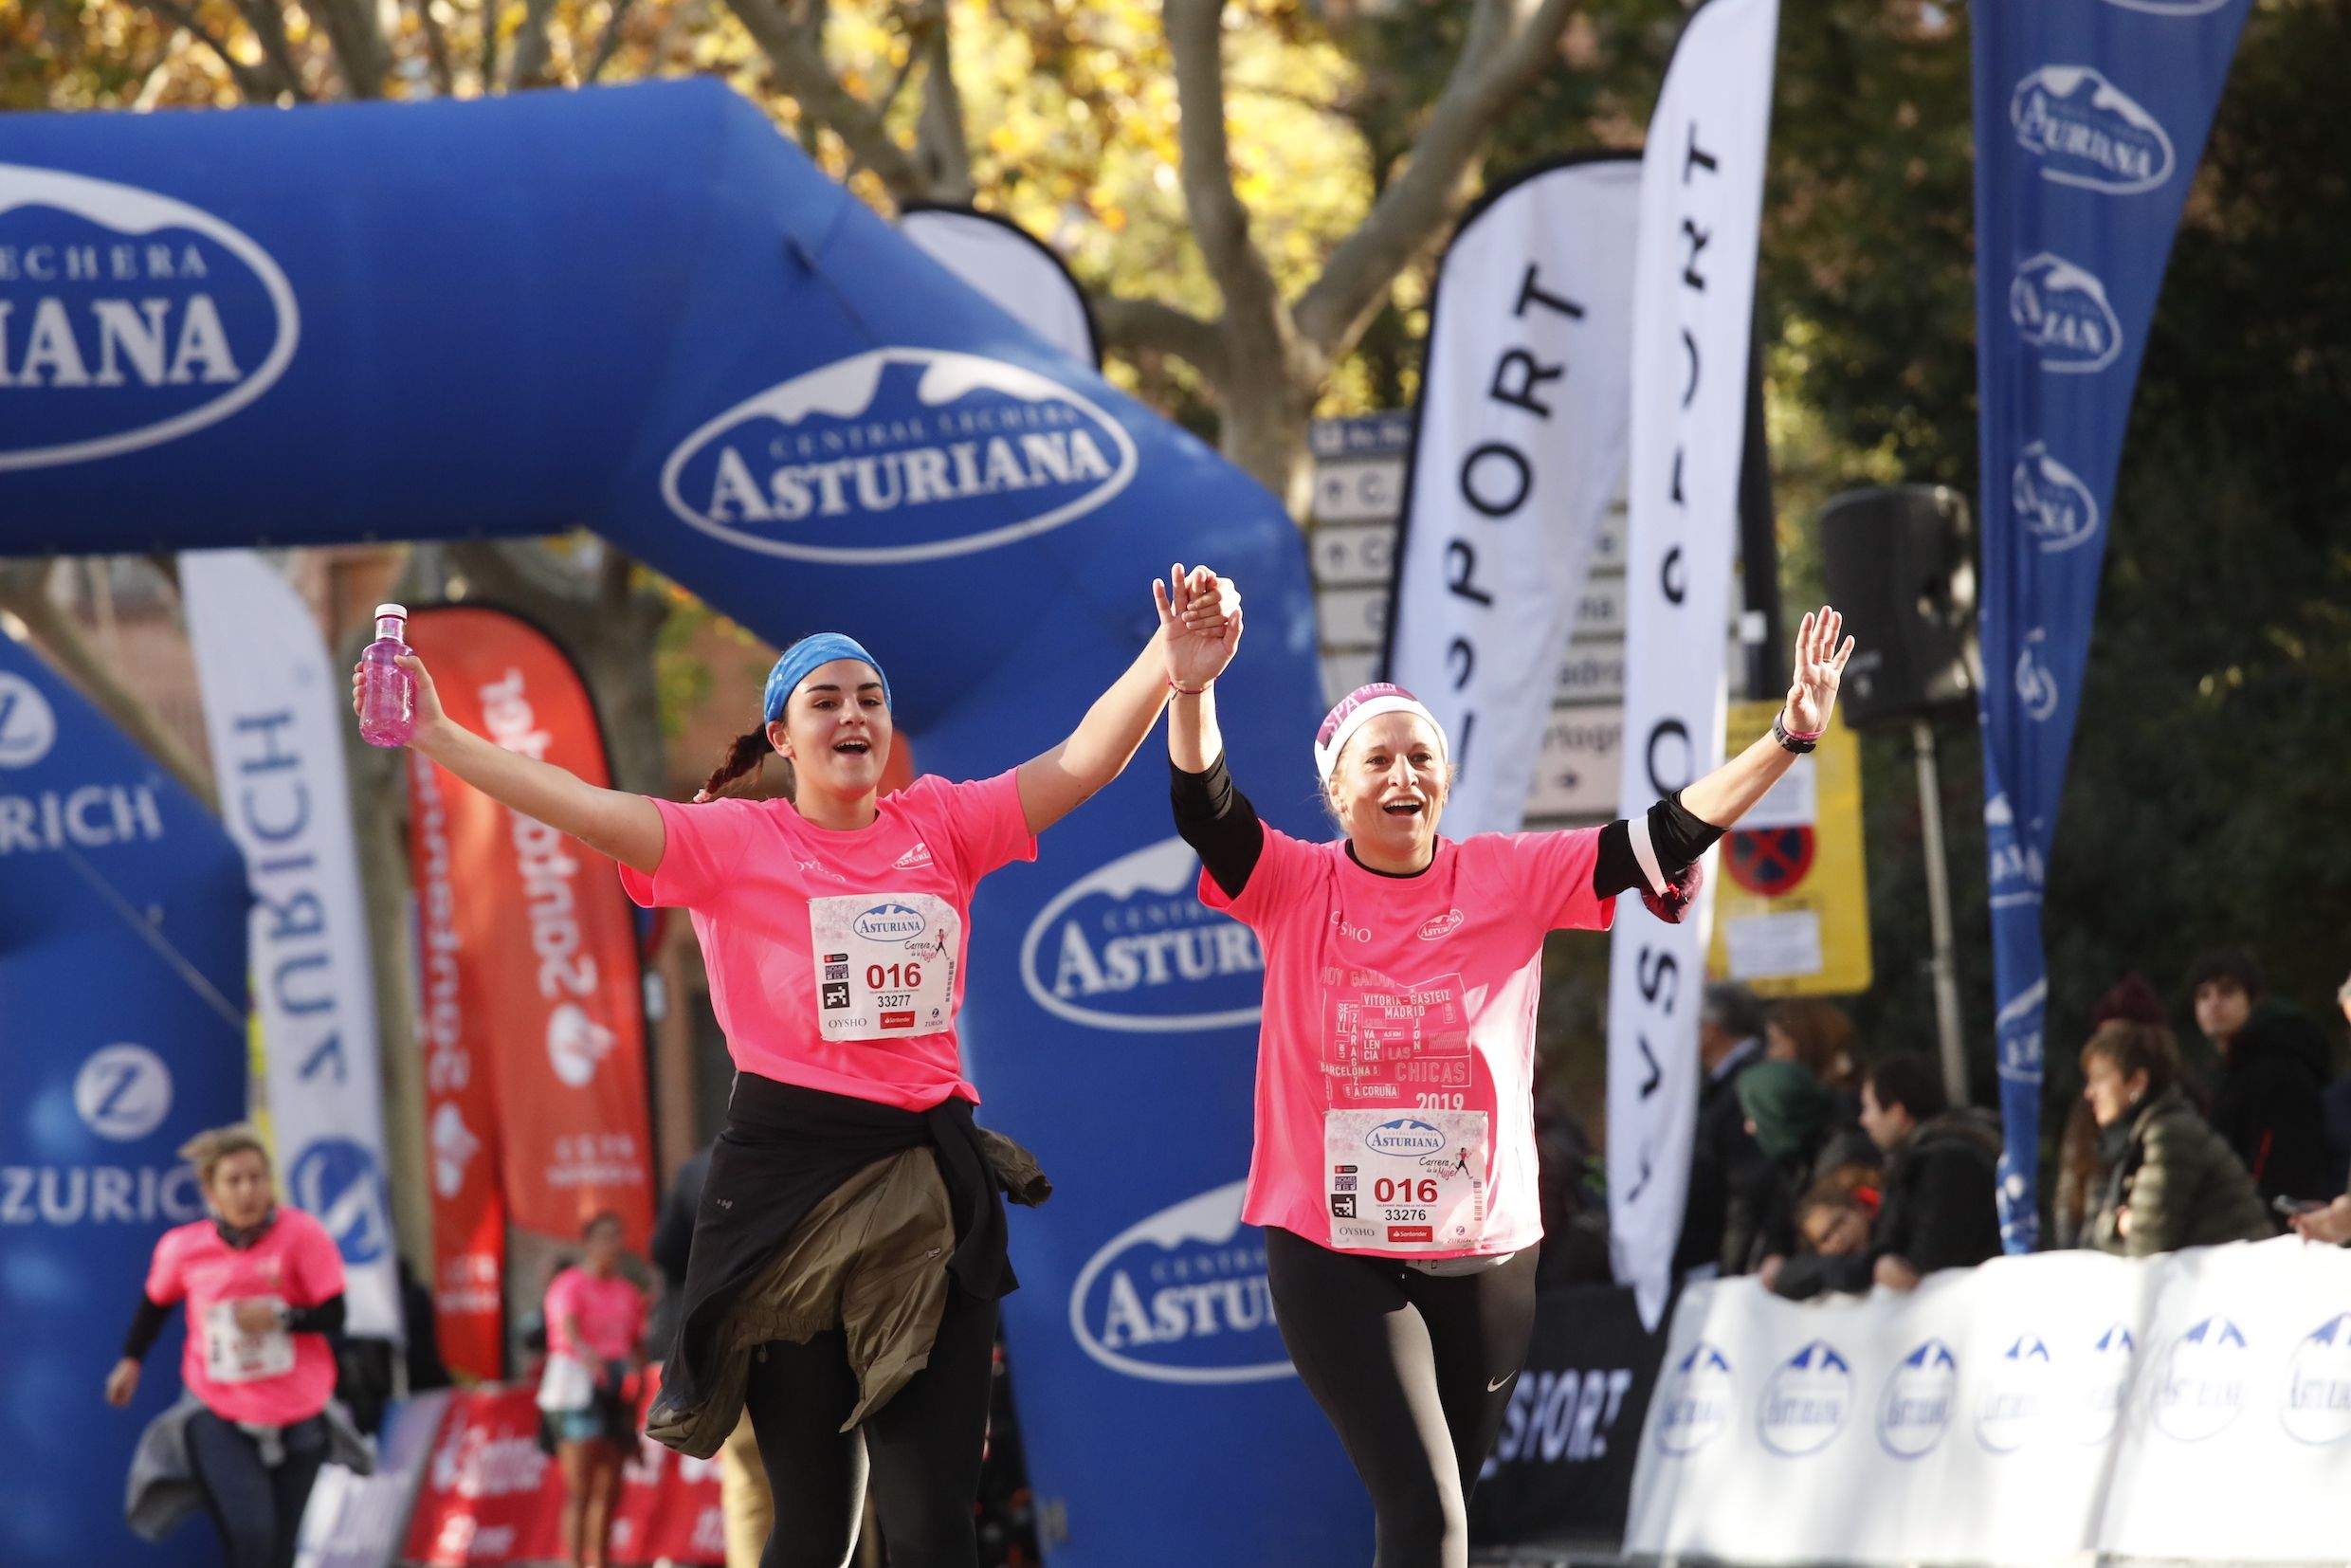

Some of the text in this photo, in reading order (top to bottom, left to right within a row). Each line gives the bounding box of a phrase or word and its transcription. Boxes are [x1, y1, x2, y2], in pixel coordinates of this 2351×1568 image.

[708, 428, 1116, 523] ASTURIANA
[859, 919, 921, 934] ASTURIANA
[904, 940, 931, 950] Carrera
[866, 962, 921, 990] 016
[877, 994, 911, 1008] 33277
[1363, 994, 1402, 1006] VITORIA
[1410, 990, 1450, 1005] GASTEIZ
[1385, 1005, 1425, 1019] MADRID
[828, 1017, 867, 1029] OYSHO
[1363, 1029, 1376, 1040] VA
[1363, 1039, 1381, 1050] LEN
[1363, 1049, 1379, 1061] CIA
[1387, 1047, 1412, 1060] LAS
[1395, 1061, 1466, 1083] CHICAS
[1362, 1084, 1398, 1097] CORUÑA
[1415, 1092, 1465, 1110] 2019
[1372, 1132, 1440, 1147] ASTURIANA
[1419, 1157, 1449, 1167] Carrera
[1374, 1177, 1438, 1203] 016
[1384, 1209, 1427, 1221] 33276
[1339, 1226, 1376, 1237] OYSHO
